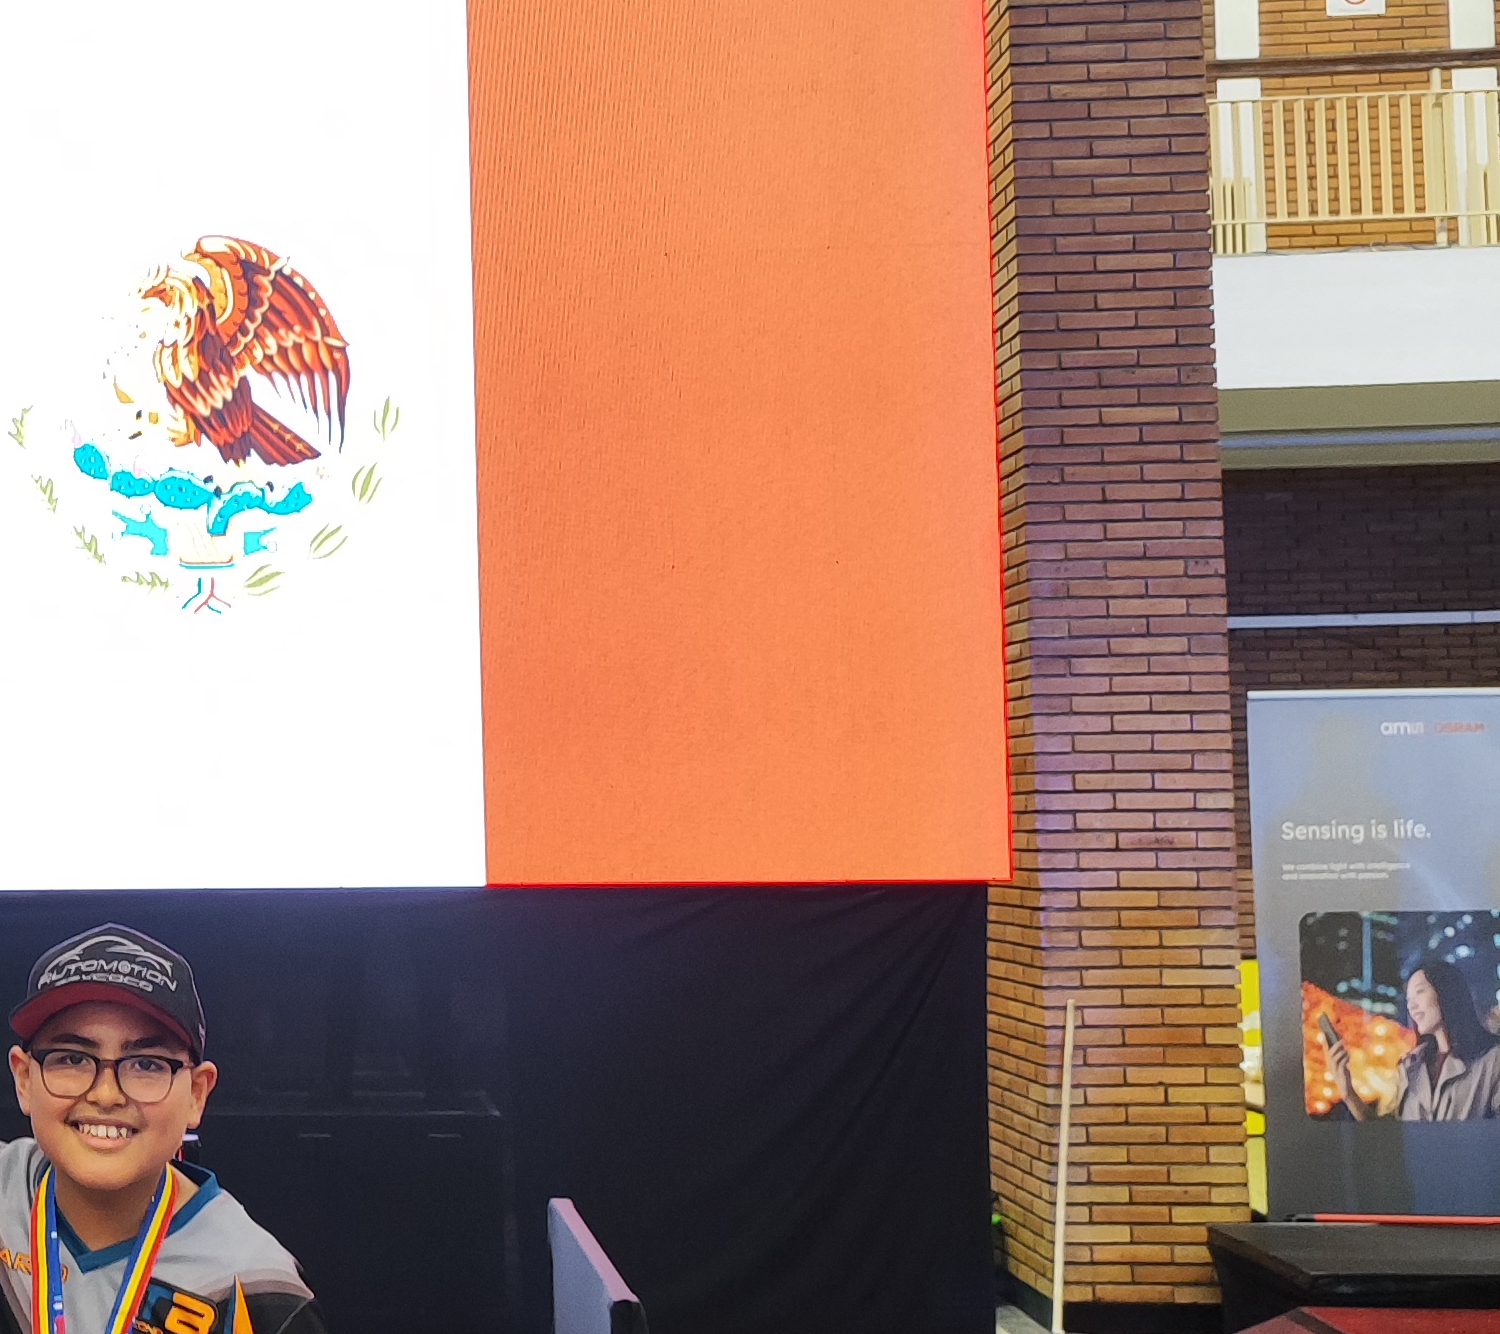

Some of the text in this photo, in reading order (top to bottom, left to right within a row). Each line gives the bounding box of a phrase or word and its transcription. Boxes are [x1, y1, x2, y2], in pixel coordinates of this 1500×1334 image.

[1281, 818, 1432, 845] Sensing is life.
[37, 959, 179, 993] AUTOMOTION
